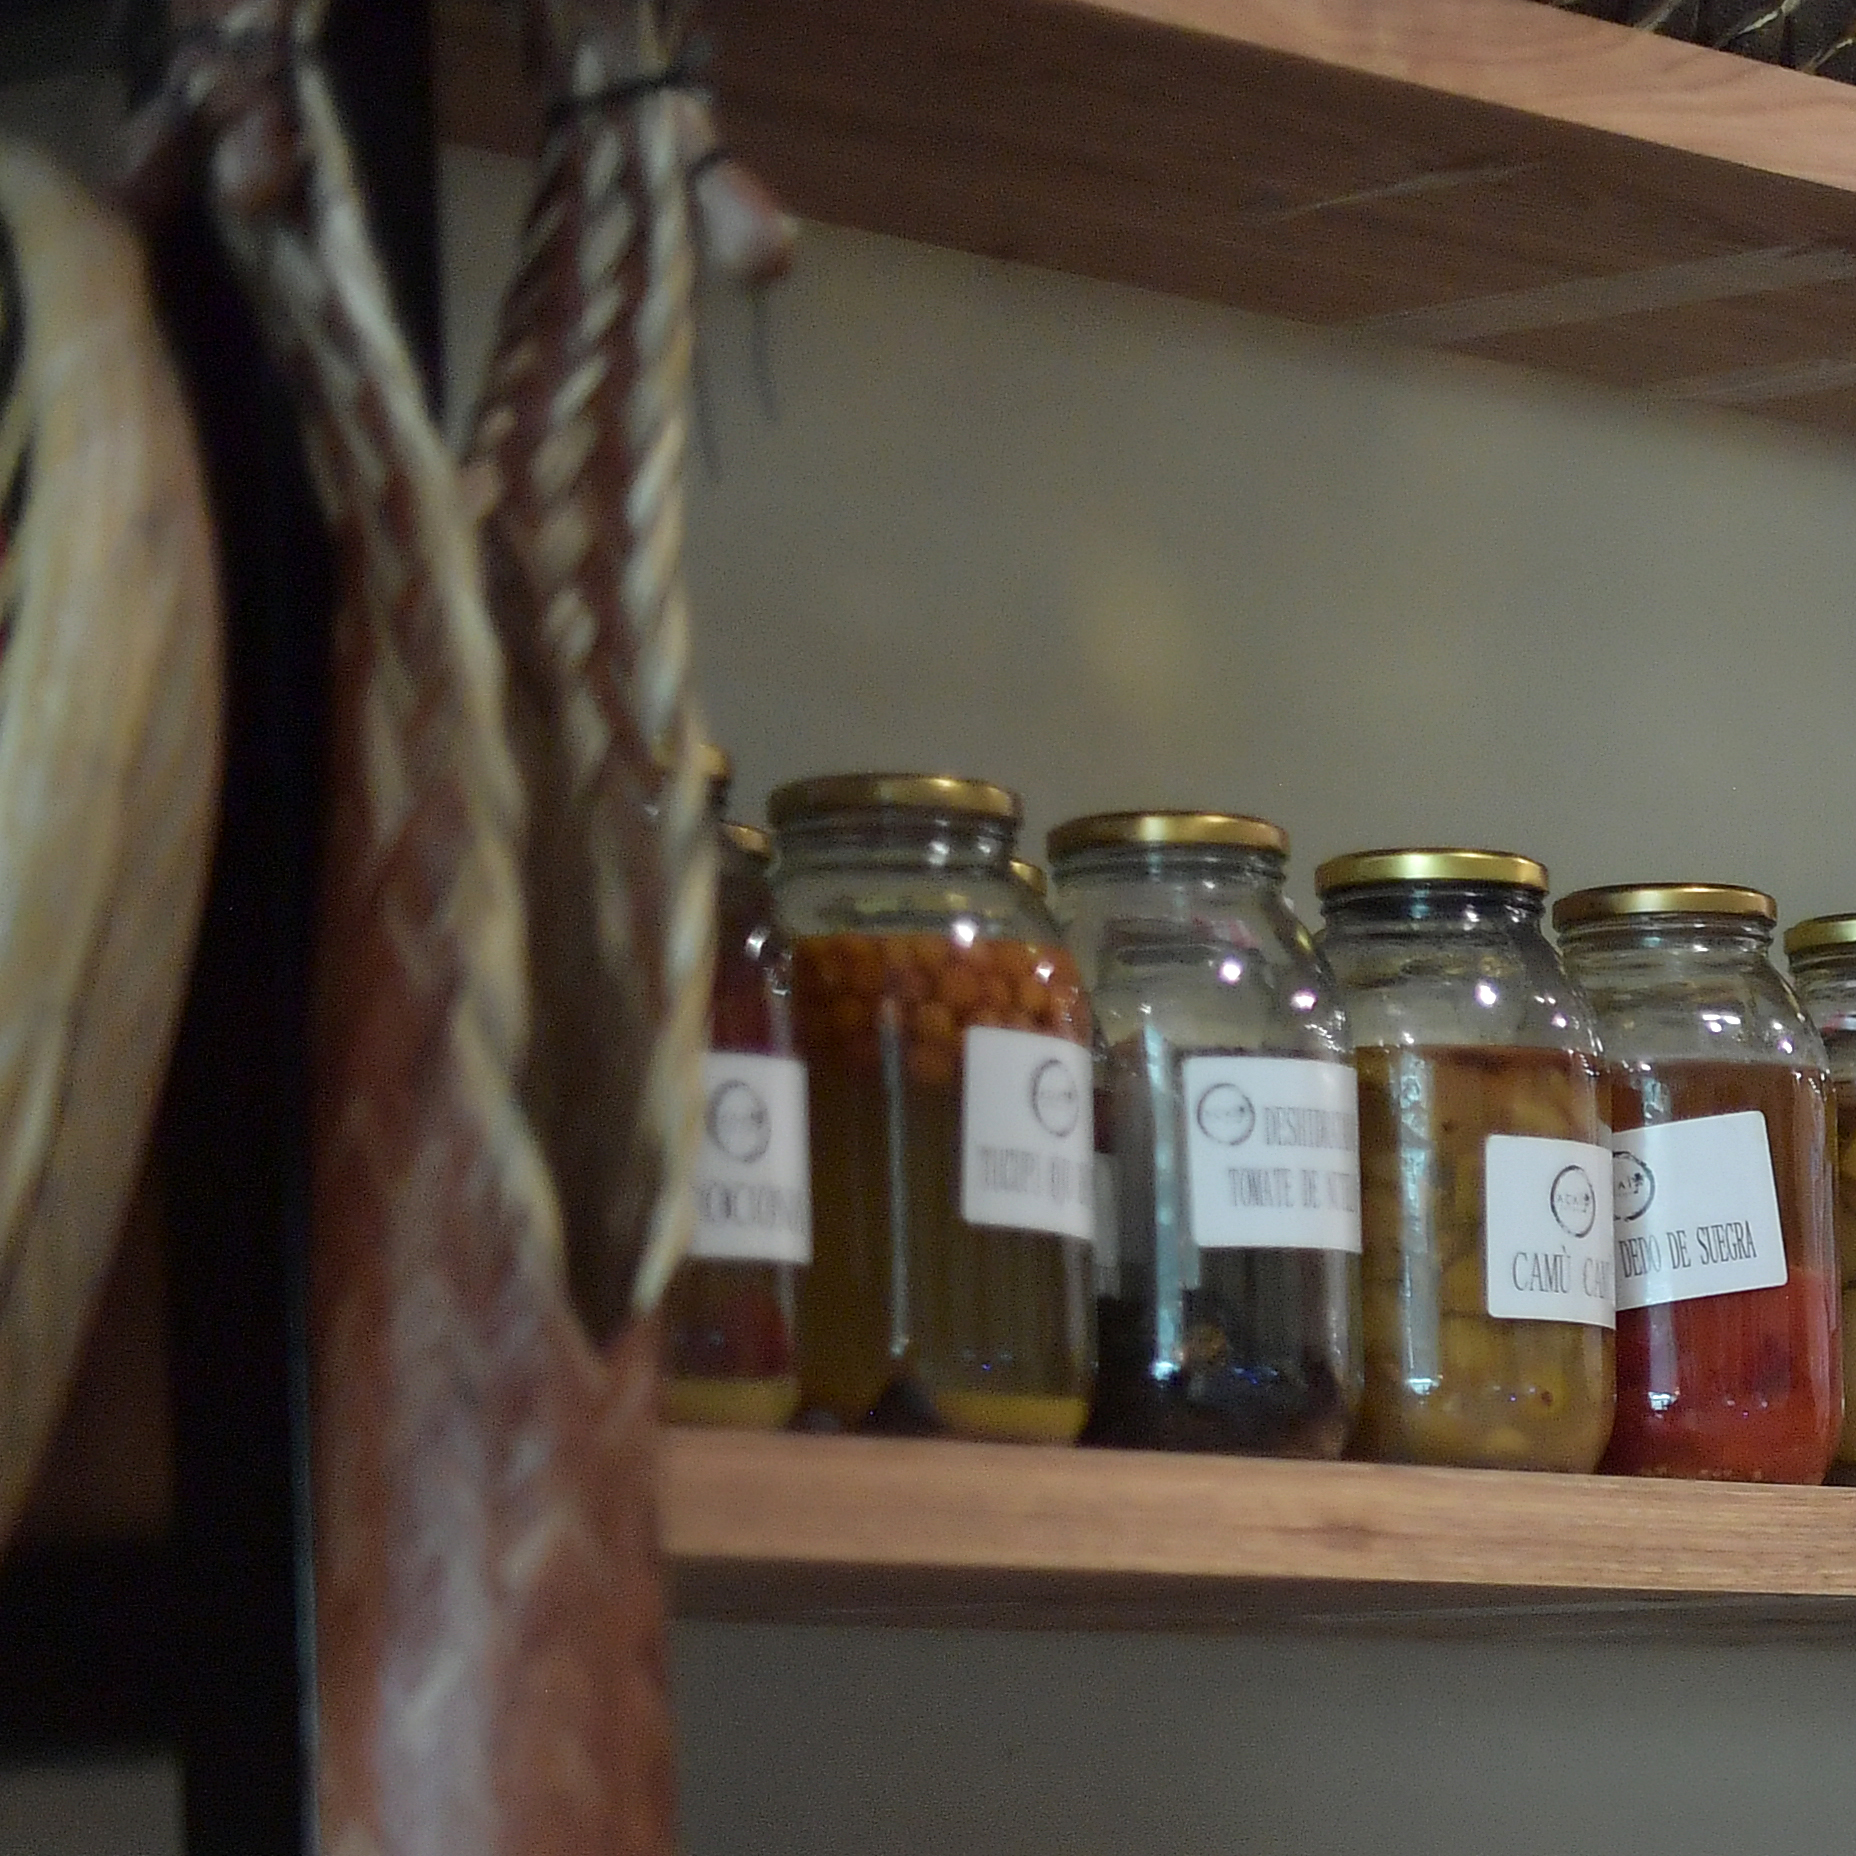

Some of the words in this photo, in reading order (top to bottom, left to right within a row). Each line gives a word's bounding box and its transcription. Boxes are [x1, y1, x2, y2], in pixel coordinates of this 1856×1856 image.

[1228, 1168, 1294, 1208] TOMATE
[1618, 1235, 1662, 1278] DEDO
[1667, 1230, 1692, 1270] DE
[1696, 1220, 1758, 1266] SUEGRA
